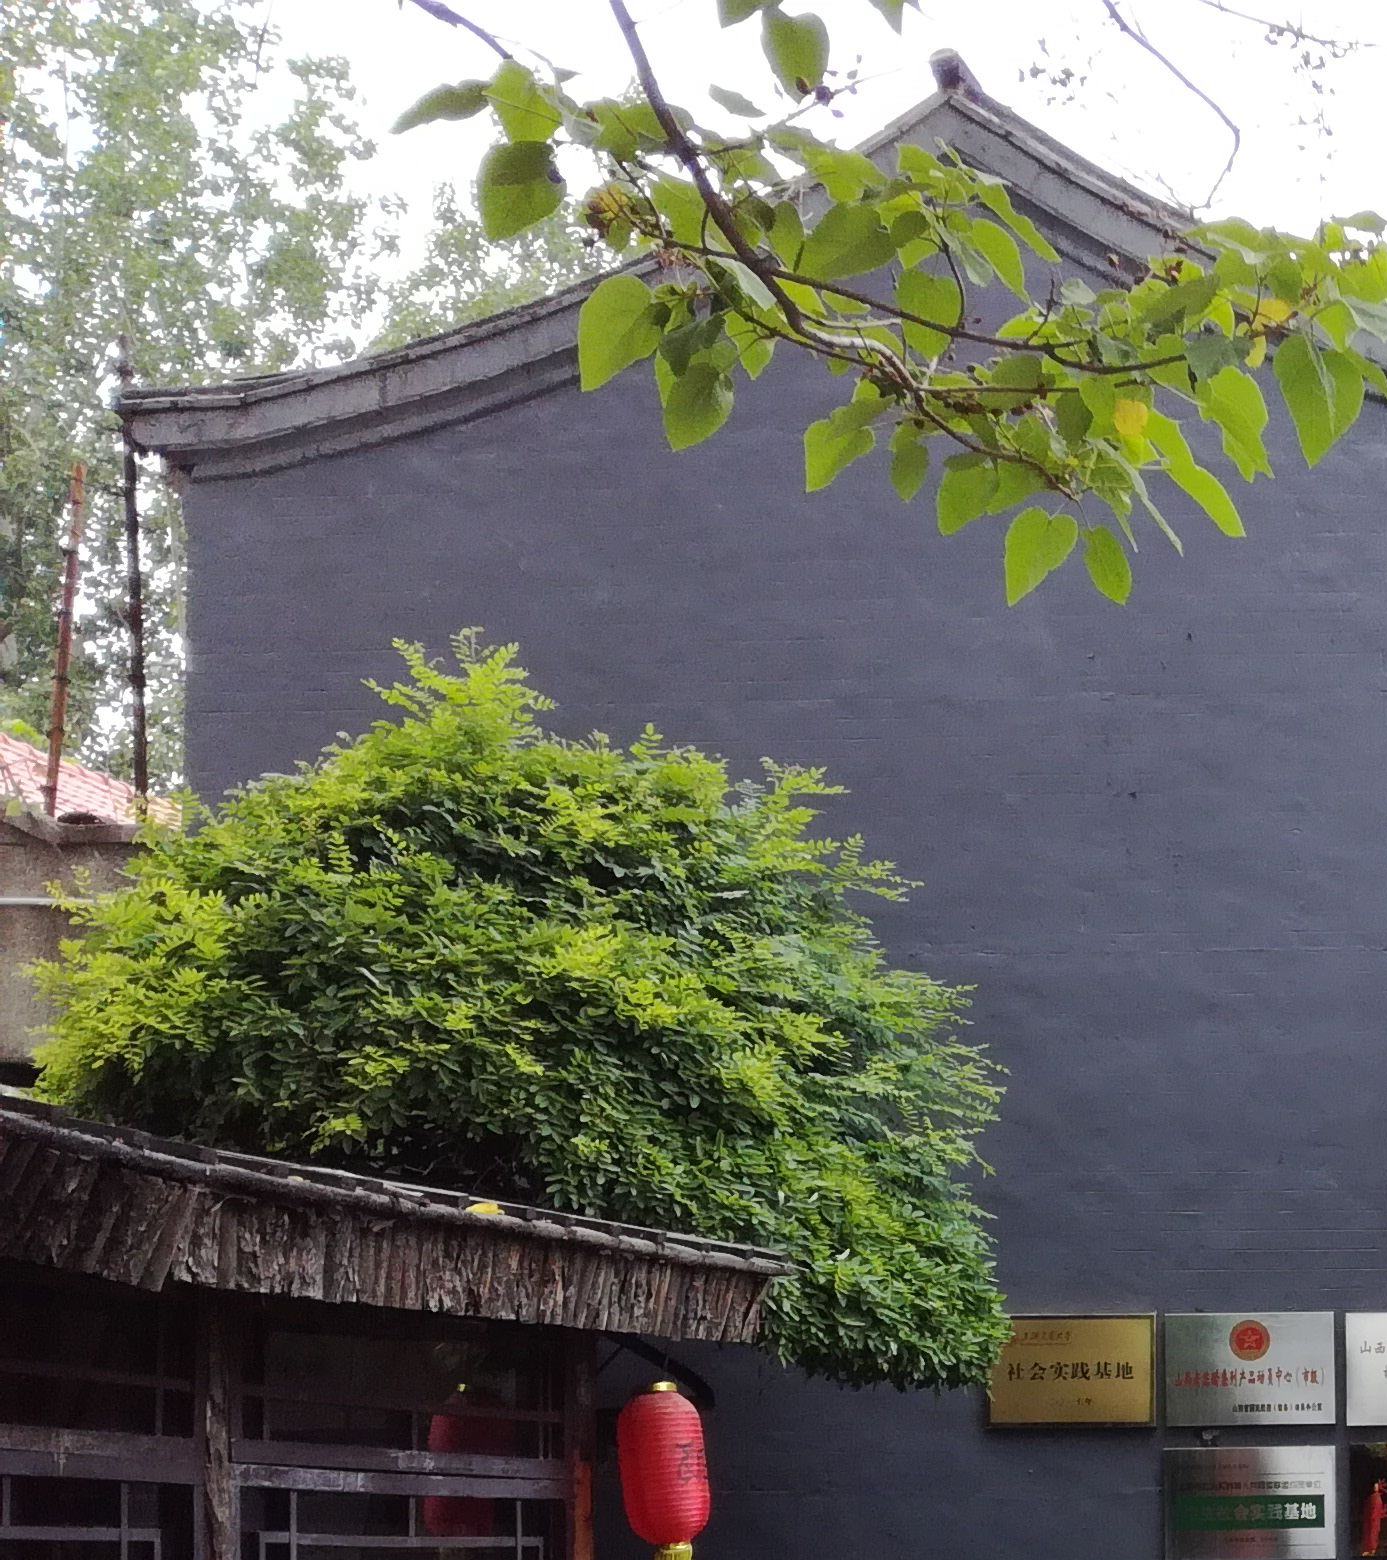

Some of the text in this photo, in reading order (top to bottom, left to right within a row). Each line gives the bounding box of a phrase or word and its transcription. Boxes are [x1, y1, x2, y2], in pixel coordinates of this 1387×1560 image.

[1007, 1361, 1135, 1382] 社会实践基地
